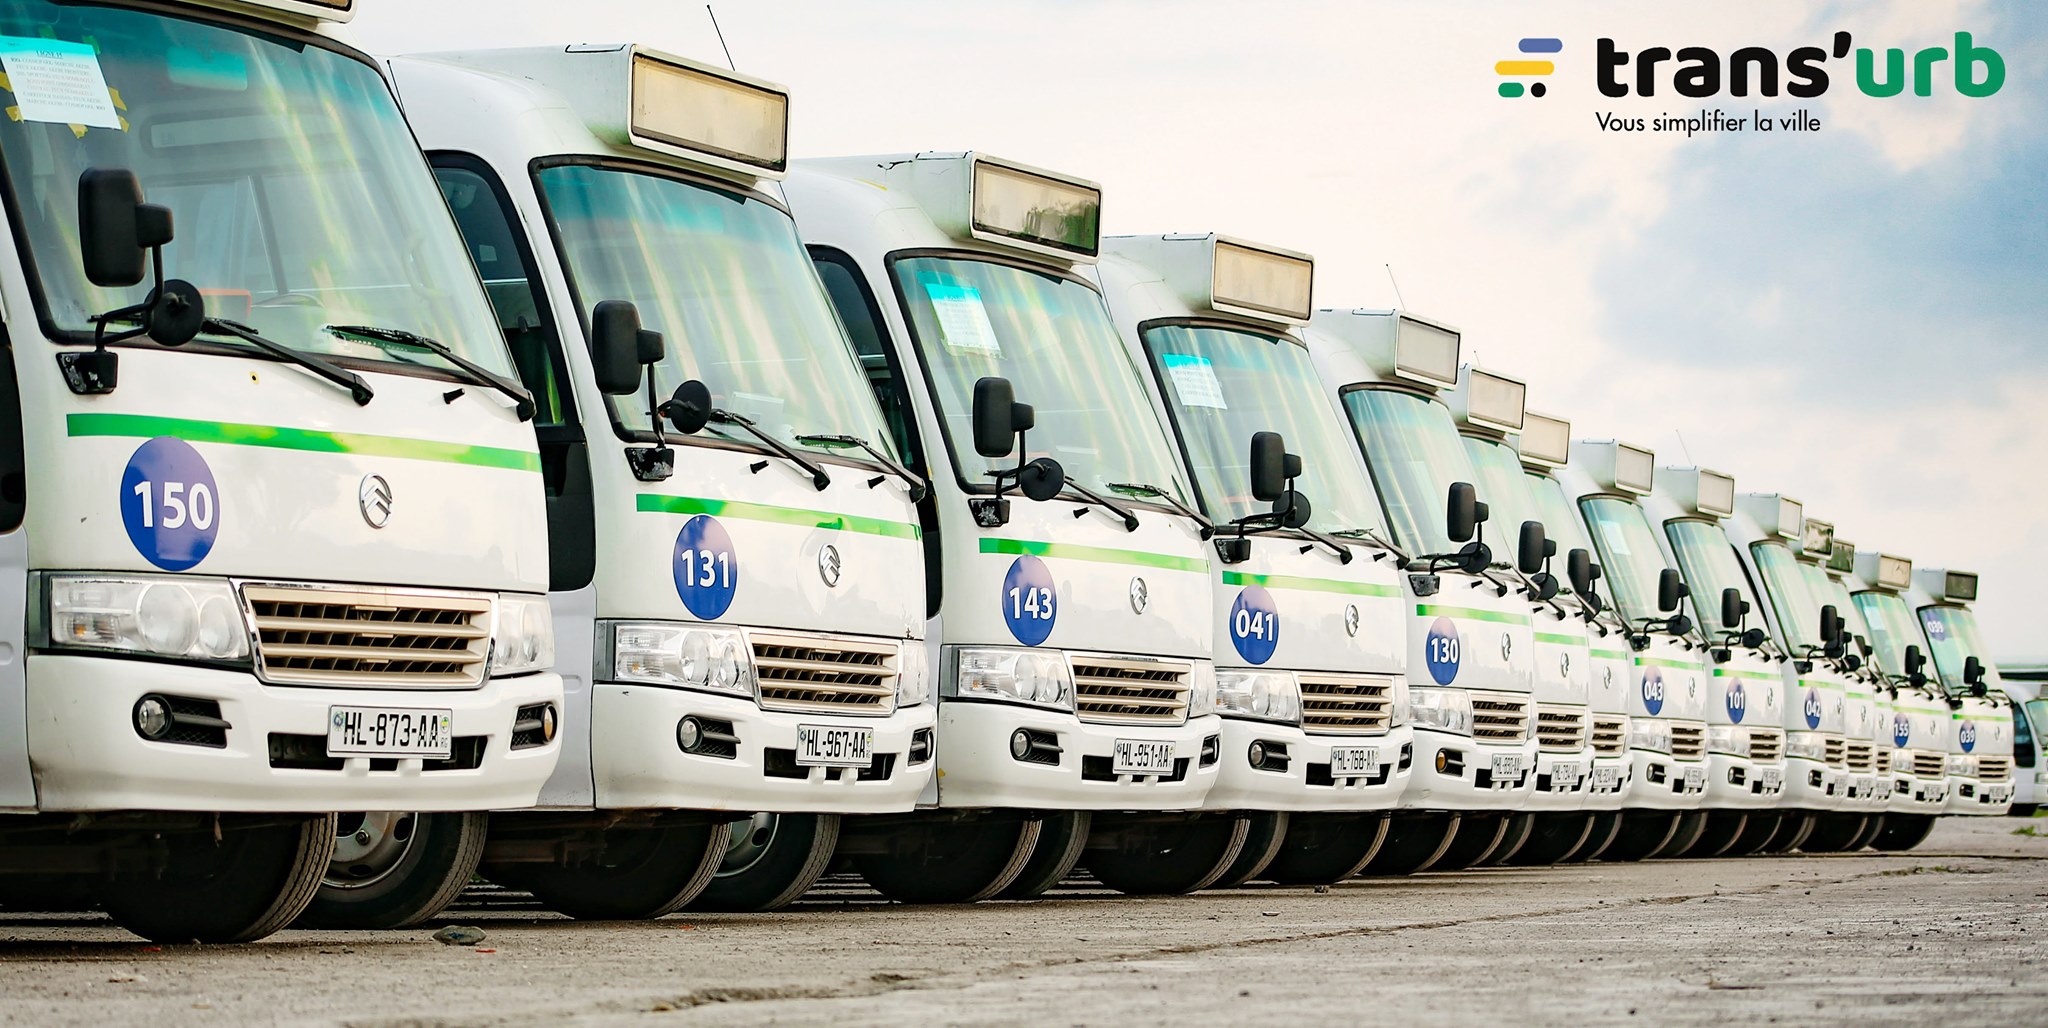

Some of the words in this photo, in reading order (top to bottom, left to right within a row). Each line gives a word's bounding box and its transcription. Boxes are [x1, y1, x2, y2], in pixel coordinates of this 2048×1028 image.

[134, 481, 214, 531] 150
[682, 549, 730, 588] 131
[1009, 587, 1053, 620] 143
[1235, 609, 1274, 642] 041
[1430, 637, 1459, 664] 130
[1644, 681, 1663, 701] 043
[1728, 691, 1744, 710] 101
[1806, 700, 1821, 717] 042
[344, 711, 439, 748] HL-873-AA
[1894, 723, 1909, 737] 155
[1960, 730, 1975, 743] 039
[806, 729, 866, 759] HL-967-AA
[1121, 742, 1169, 767] HL-951-AA
[1337, 749, 1377, 770] HL-768-AA
